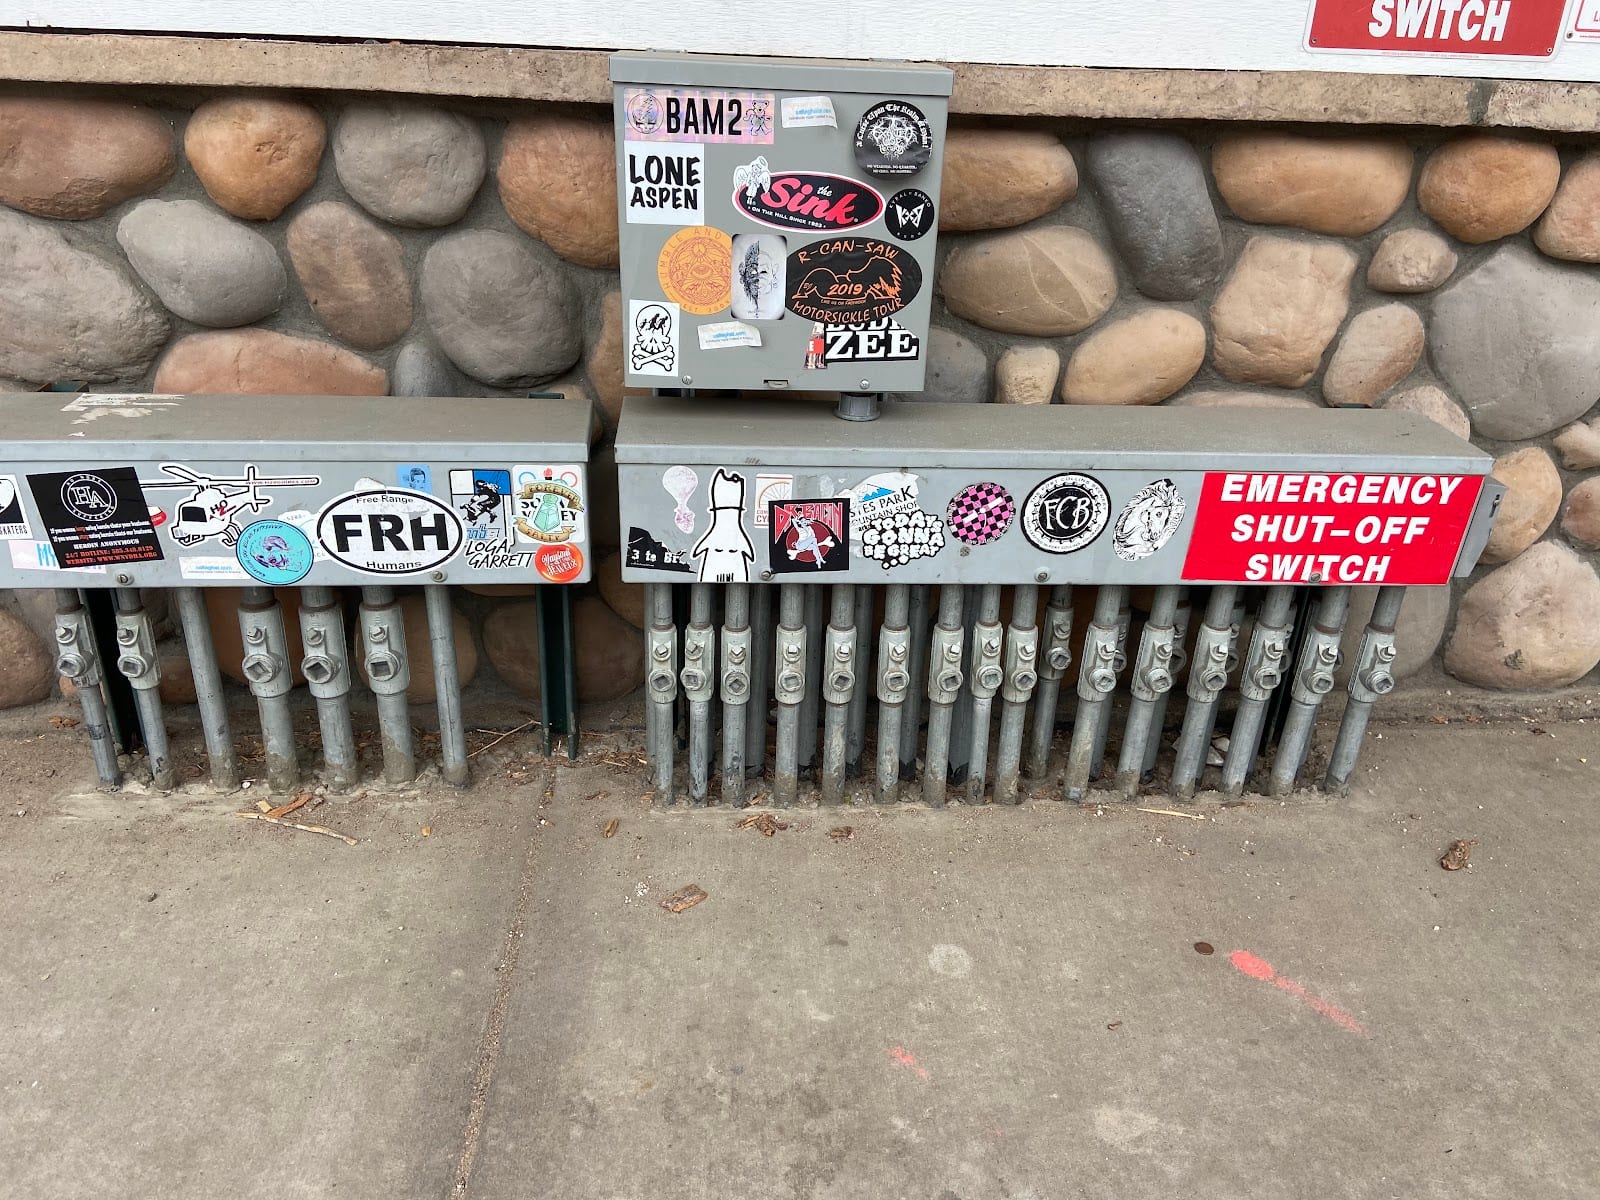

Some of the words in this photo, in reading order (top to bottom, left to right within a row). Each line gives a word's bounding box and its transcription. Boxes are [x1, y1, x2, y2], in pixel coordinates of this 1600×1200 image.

[1368, 0, 1512, 41] SWITCH
[666, 97, 742, 136] BAM2
[885, 104, 900, 112] The
[629, 154, 701, 187] LONE
[630, 186, 698, 210] ASPEN
[760, 178, 858, 224] Sink
[817, 185, 833, 197] the
[694, 228, 722, 241] AND
[798, 240, 899, 264] R-CAN-SAW
[827, 284, 863, 296] 2019
[792, 301, 870, 324] MOTORSICKLE
[873, 298, 905, 317] TOUR
[825, 330, 918, 359] ZEE
[70, 486, 109, 509] HA
[356, 494, 378, 504] Free
[381, 494, 414, 504] Range
[880, 486, 915, 508] PARK
[1220, 474, 1464, 505] EMERGENCY
[1044, 496, 1091, 530] FCB
[332, 514, 449, 552] FRH
[863, 527, 945, 546] GONNA
[1231, 514, 1430, 544] SHUT-OFF
[468, 552, 536, 568] GARRETT
[887, 544, 940, 559] GREAT
[366, 560, 422, 570] Humans
[1245, 554, 1392, 582] SWITCH
